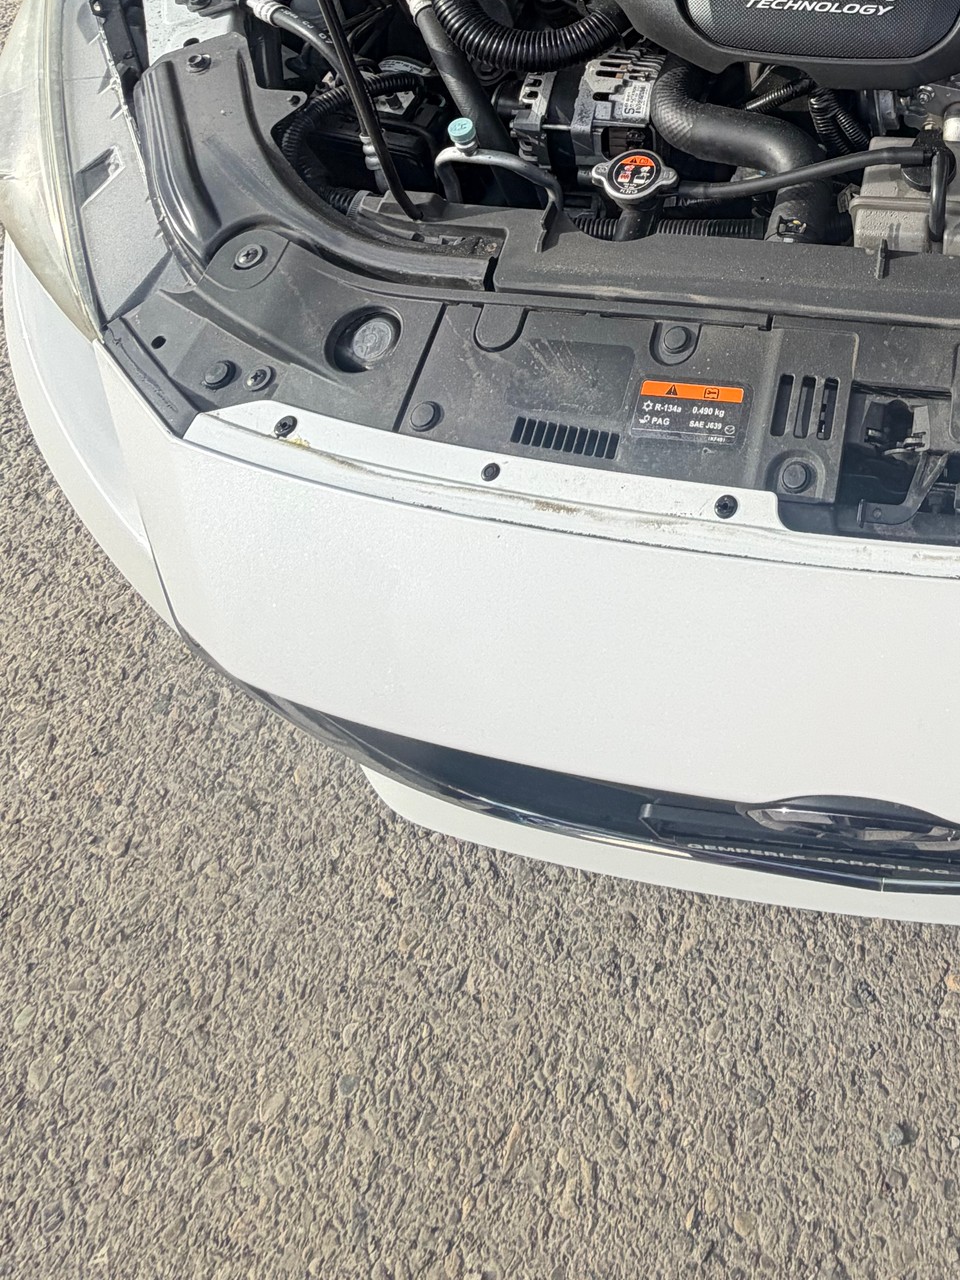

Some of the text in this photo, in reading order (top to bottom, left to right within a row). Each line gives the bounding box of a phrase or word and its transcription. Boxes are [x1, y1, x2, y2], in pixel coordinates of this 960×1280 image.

[655, 403, 725, 418] R-134a 0.490 kg
[651, 417, 722, 430] PAG SAE J639
[688, 843, 806, 860] GEMPERLE
[817, 857, 911, 870] GARAGE
[919, 867, 949, 875] AG
